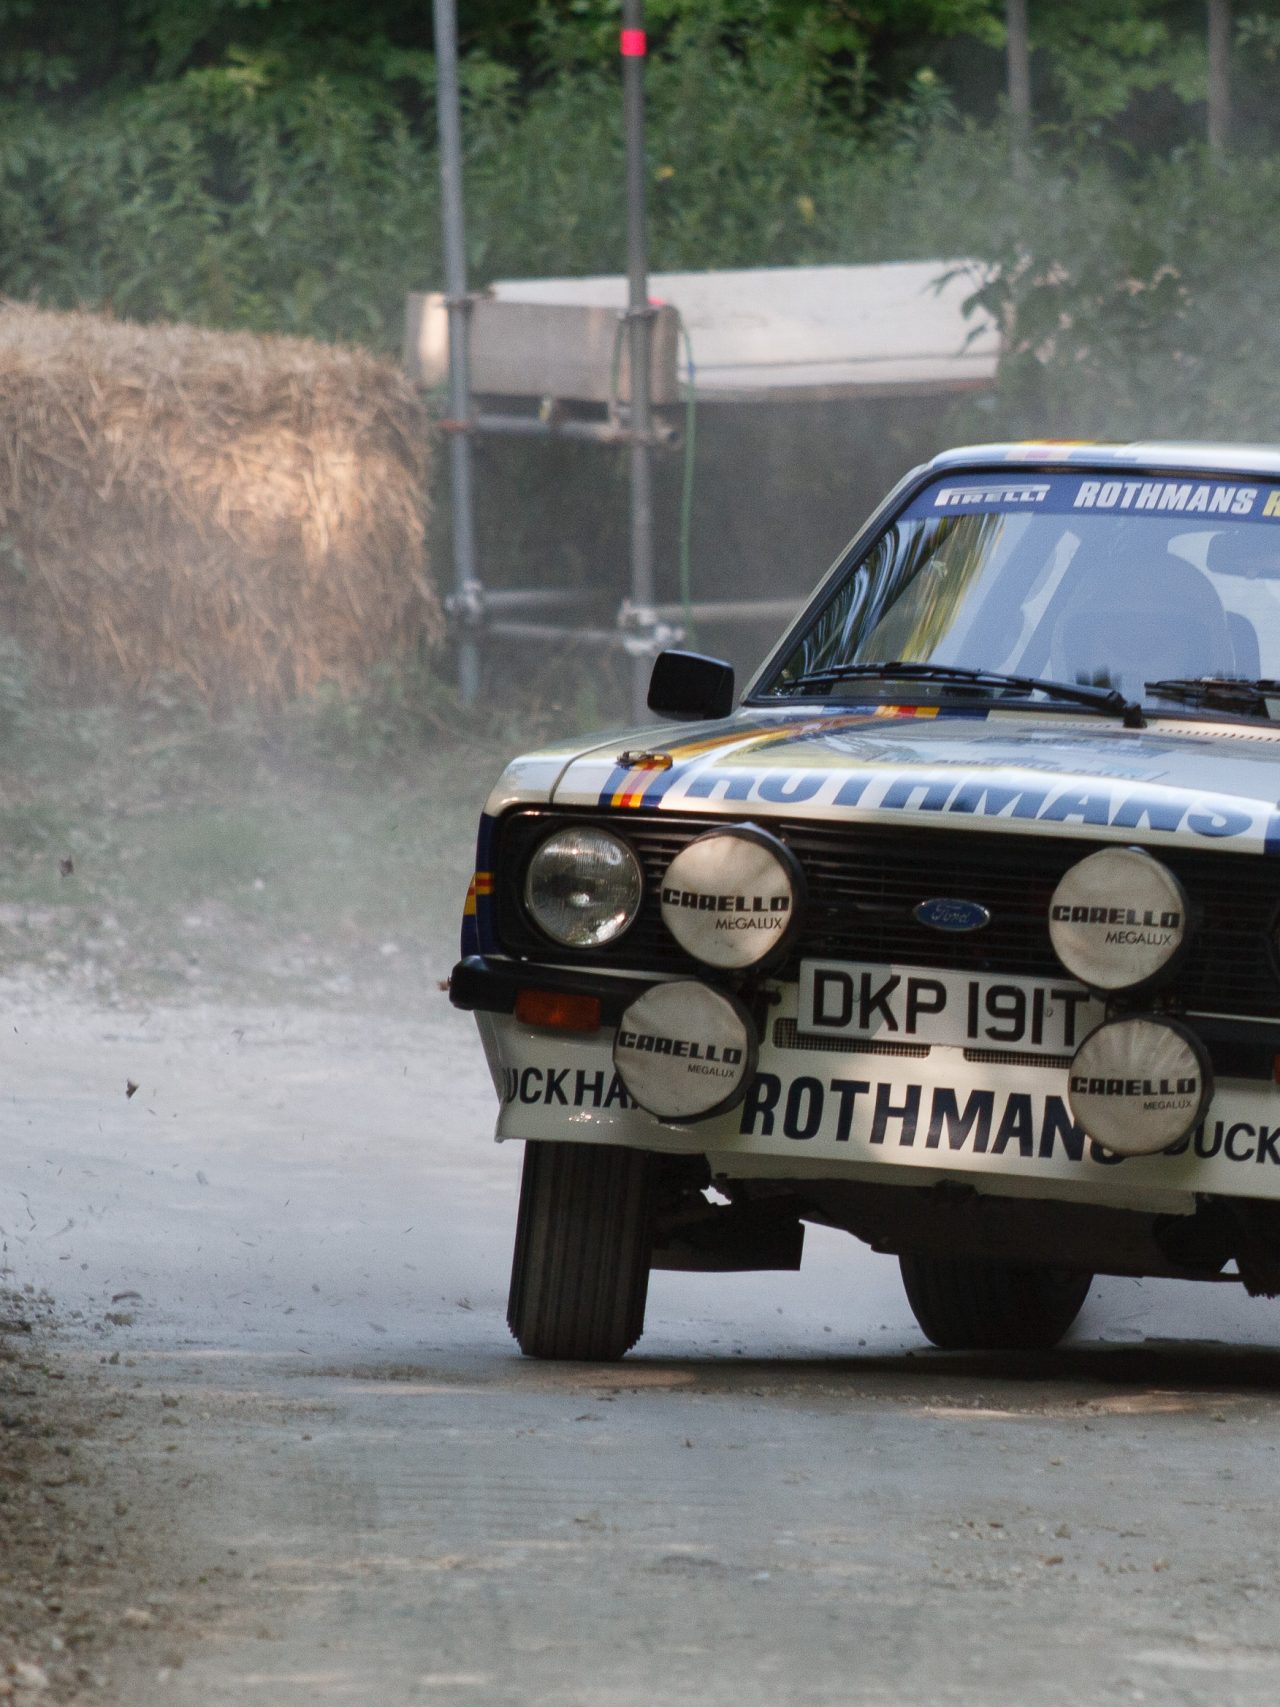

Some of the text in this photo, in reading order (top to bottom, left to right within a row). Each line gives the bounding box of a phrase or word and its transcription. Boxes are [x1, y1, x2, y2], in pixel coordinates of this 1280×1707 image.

[934, 484, 1051, 506] PIRELLI
[1073, 481, 1258, 515] ROTHMANS
[662, 888, 790, 912] CARELLO
[715, 917, 783, 930] MEGALUX
[931, 903, 972, 923] Ford
[1052, 905, 1181, 929] CARELLO
[1105, 931, 1172, 945] MEGALUX
[813, 969, 1090, 1047] DKP 191T
[618, 1031, 743, 1064] CARELLO
[687, 1064, 735, 1079] MEGALUX
[501, 1067, 639, 1110] UCKHA
[1071, 1077, 1196, 1096] CARELLO
[1144, 1100, 1192, 1111] MEGALUX
